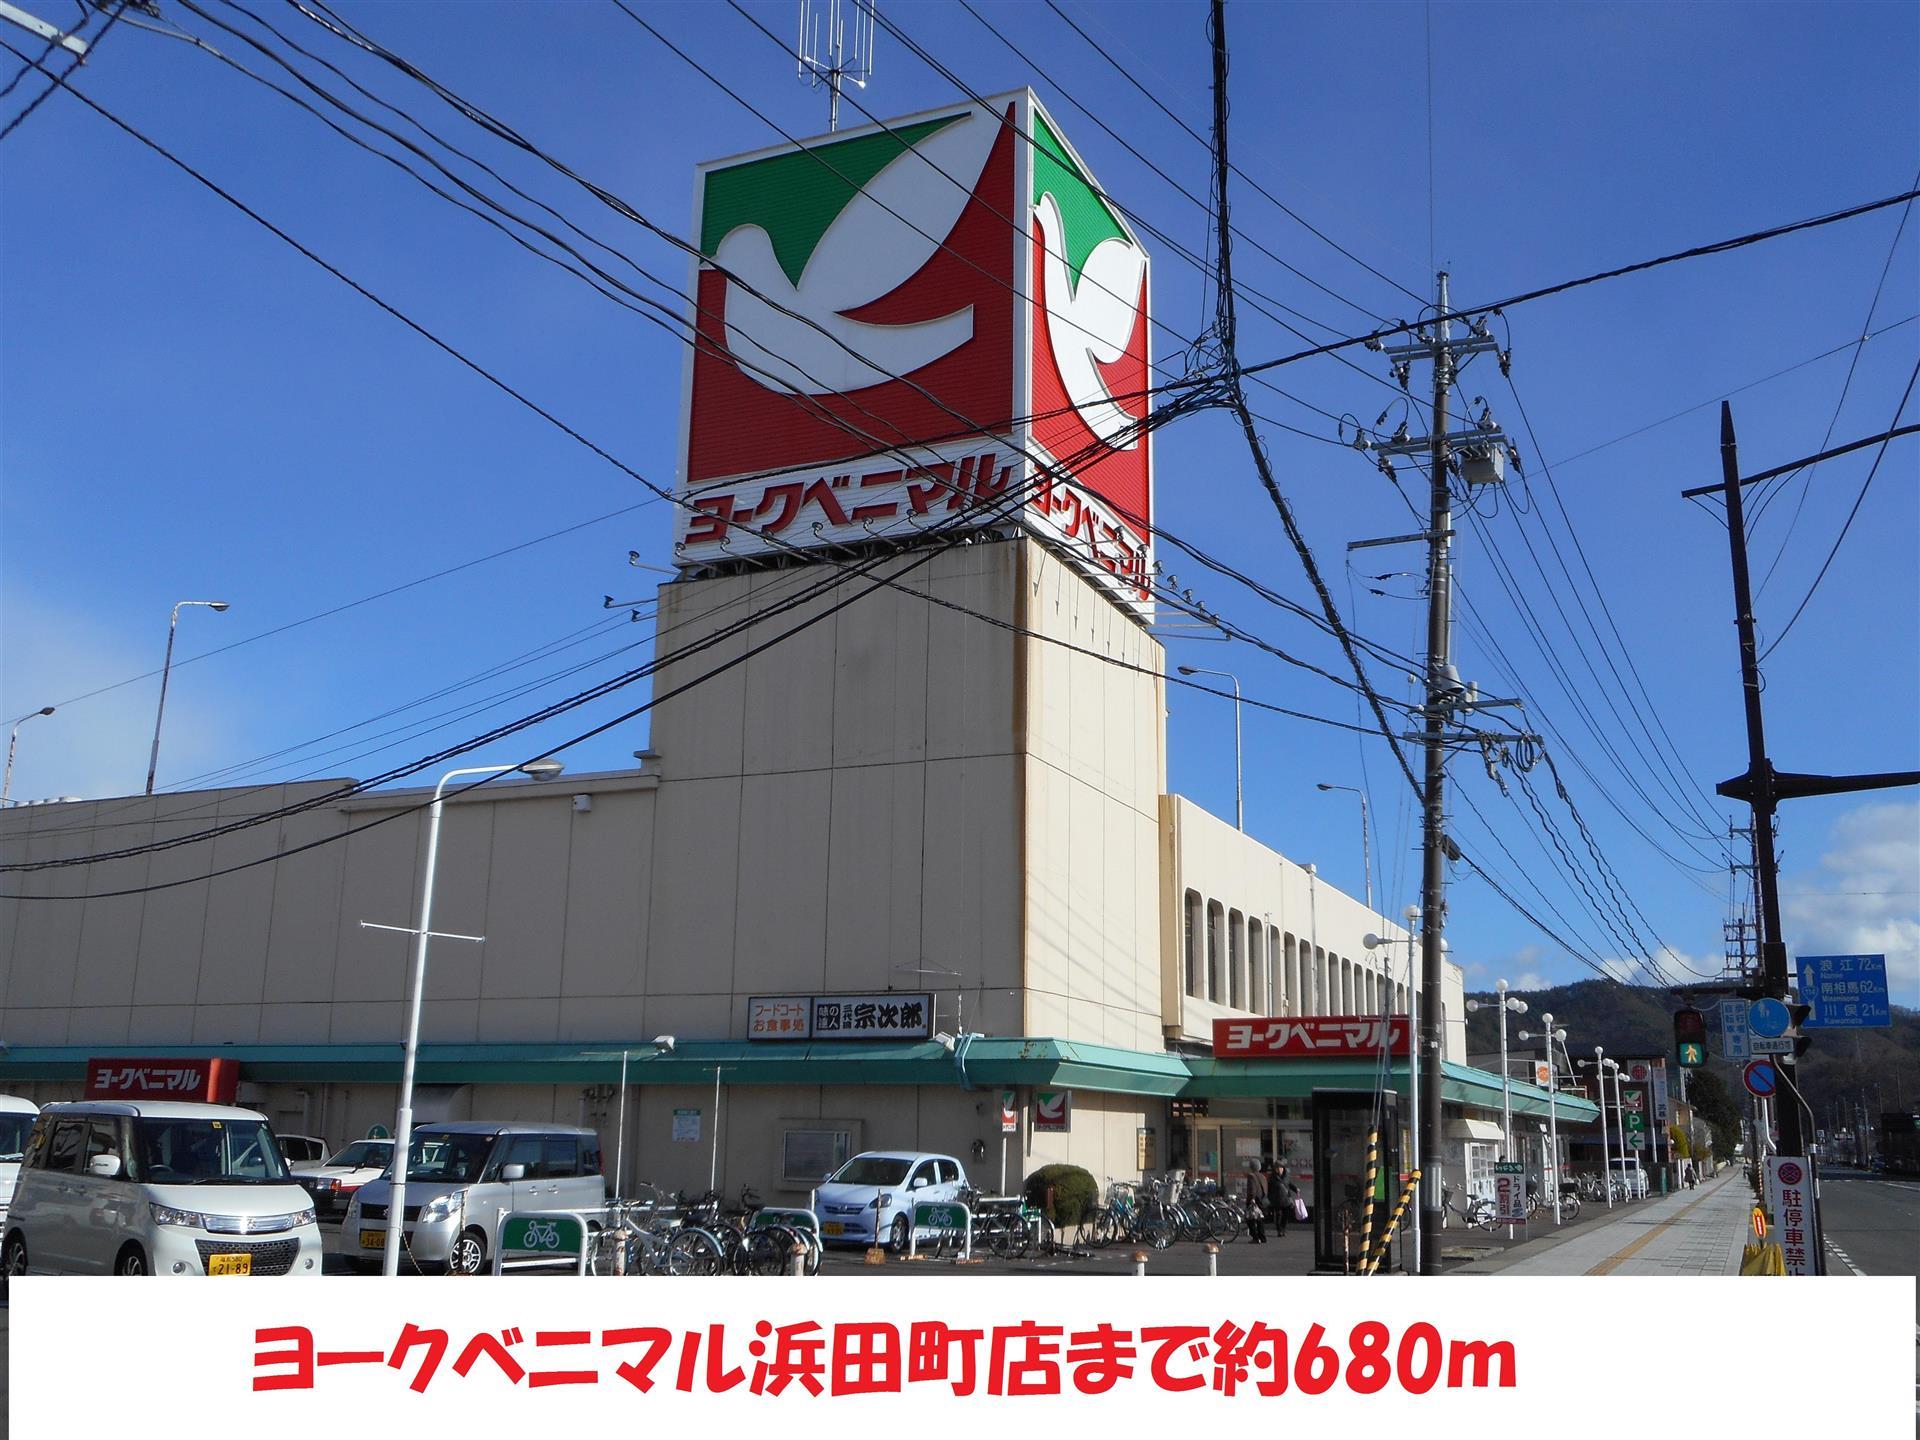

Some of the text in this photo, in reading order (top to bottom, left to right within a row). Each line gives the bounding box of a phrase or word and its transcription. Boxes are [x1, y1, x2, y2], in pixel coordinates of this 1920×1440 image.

[685, 453, 1012, 545] ヨークベニマル
[1820, 960, 1854, 971] 浪江
[1821, 982, 1859, 994] 南相馬
[755, 1004, 805, 1017] フードコート
[854, 1002, 923, 1029] 宗次郎
[754, 1019, 805, 1032] お食事処
[1226, 1022, 1401, 1049] ヨークベニマル
[94, 1068, 202, 1091] ヨークベニマル
[1629, 1115, 1640, 1129] P
